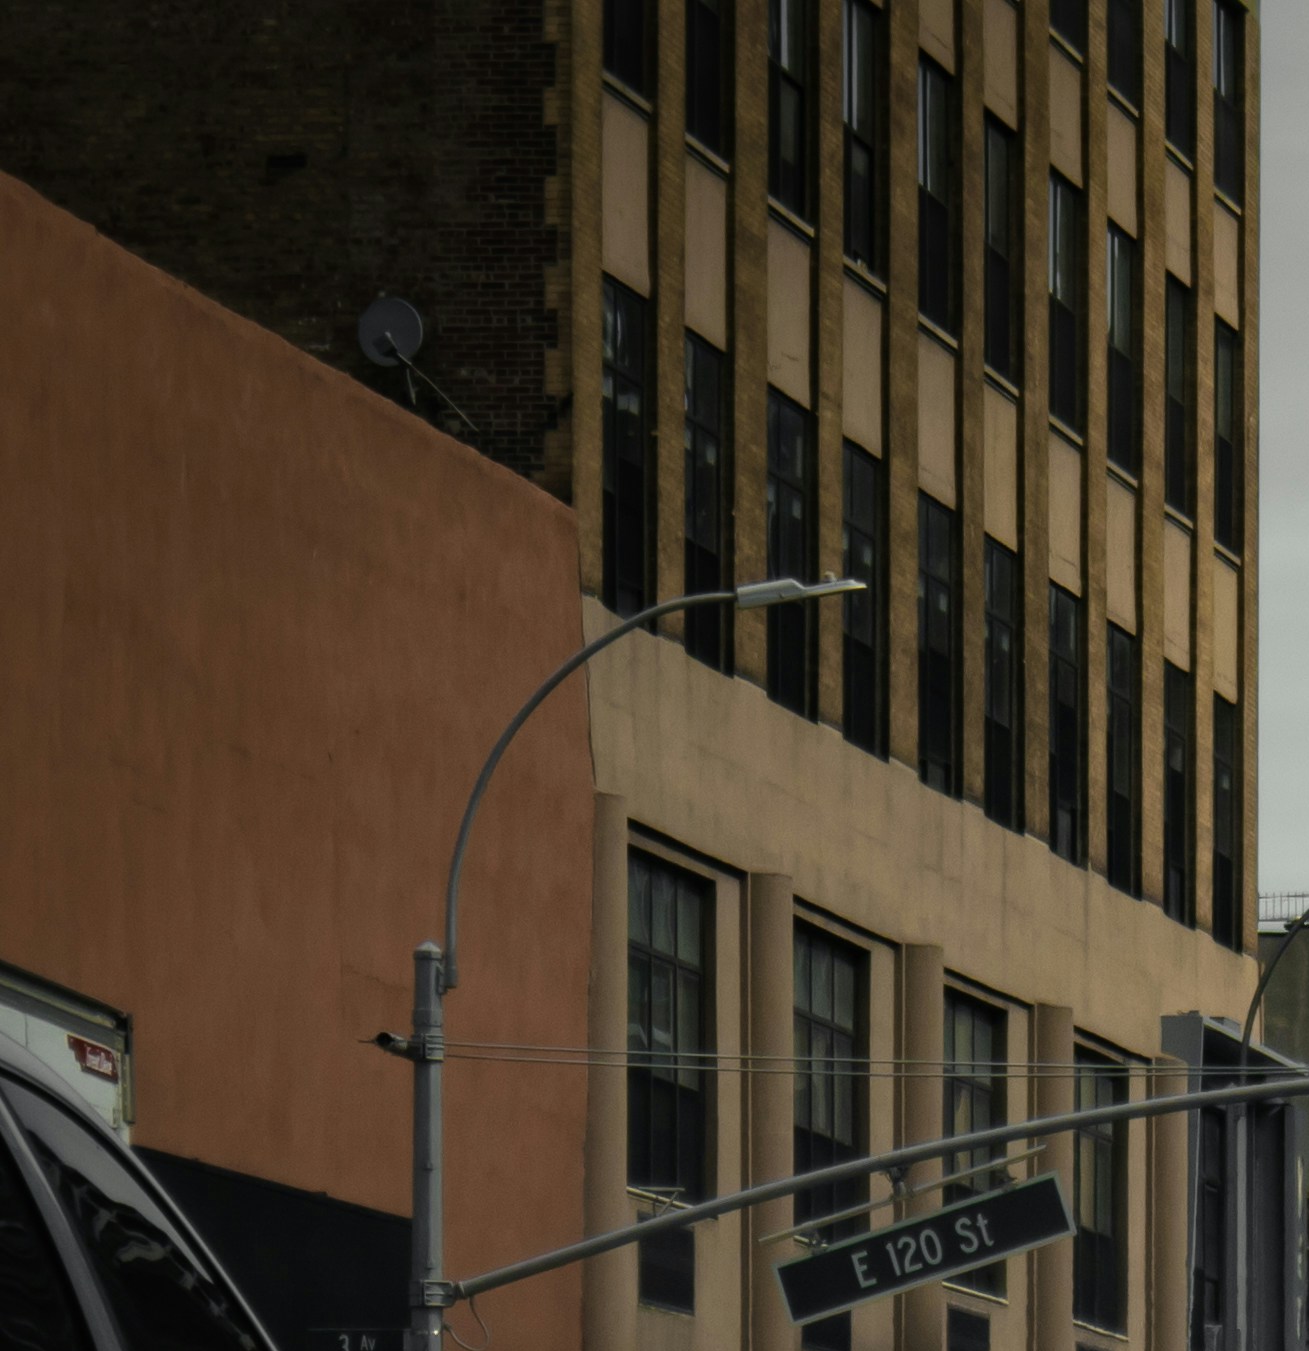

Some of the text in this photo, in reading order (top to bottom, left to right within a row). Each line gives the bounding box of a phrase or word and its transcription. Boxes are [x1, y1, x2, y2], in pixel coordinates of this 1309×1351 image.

[851, 1213, 995, 1288] E 120 St
[360, 1335, 377, 1351] Av
